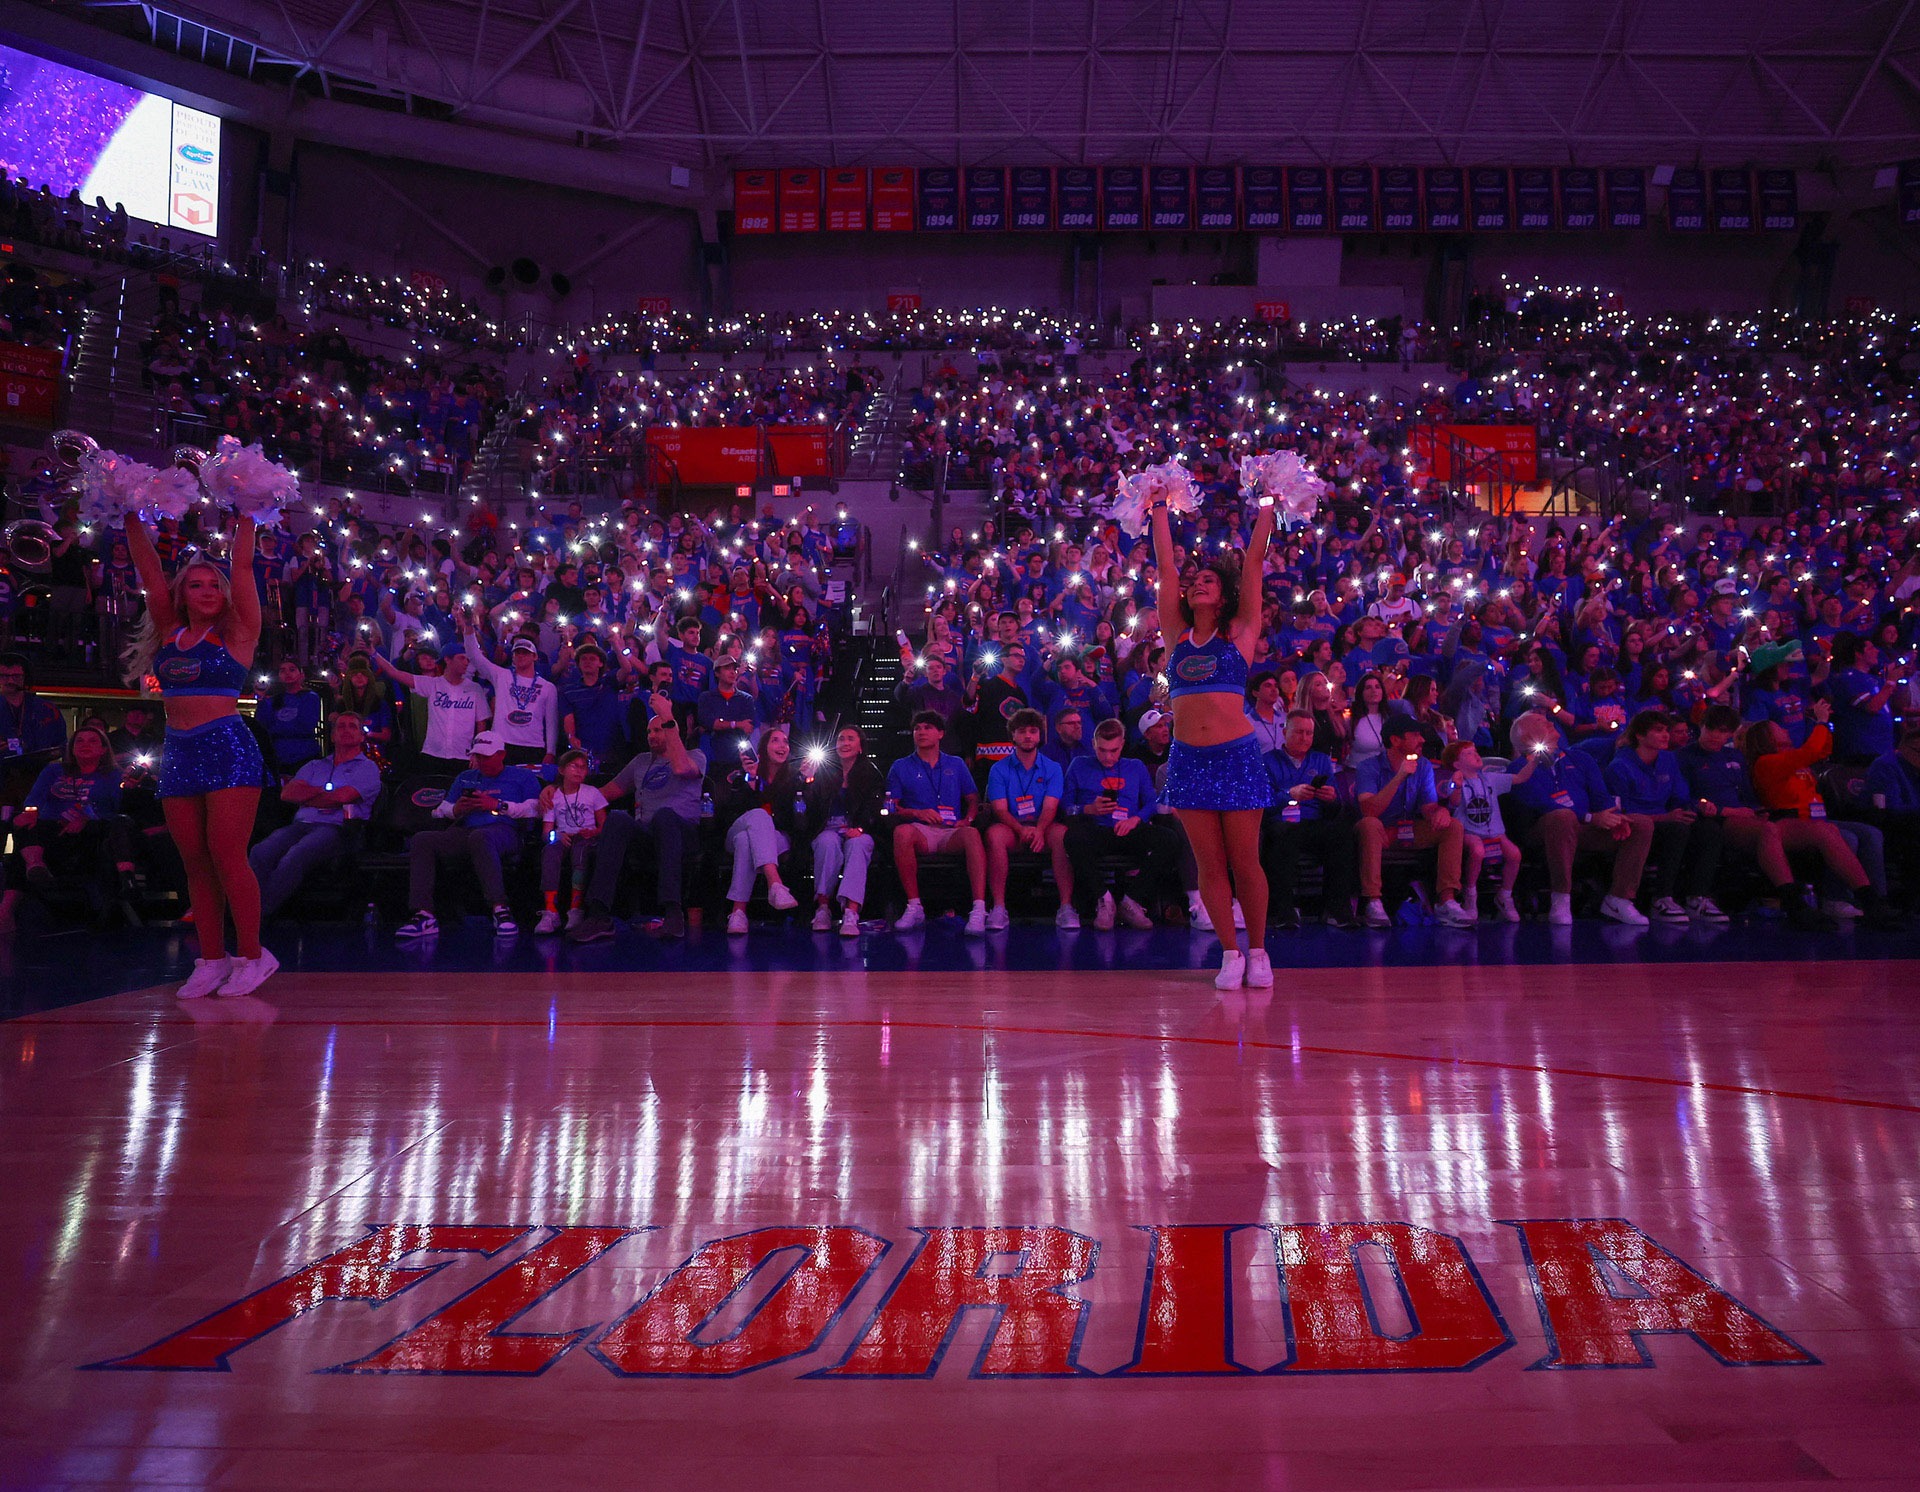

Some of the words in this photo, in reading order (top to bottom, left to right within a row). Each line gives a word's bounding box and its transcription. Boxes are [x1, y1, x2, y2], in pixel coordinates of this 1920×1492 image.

[176, 111, 217, 129] PROUD
[742, 217, 768, 229] 1982
[926, 214, 953, 226] 1994
[972, 213, 1000, 226] 1997
[1018, 213, 1045, 225] 1998
[1062, 213, 1093, 225] 2004
[1108, 213, 1138, 225] 2006
[1154, 213, 1185, 224] 2007
[1201, 213, 1232, 225] 2008
[1249, 213, 1279, 224] 2009
[1296, 213, 1323, 225] 2010
[1341, 214, 1368, 226] 2012
[1386, 214, 1413, 226] 2013
[1432, 214, 1459, 226] 2014
[1477, 214, 1504, 226] 2015
[1522, 214, 1549, 226] 2016
[1567, 214, 1594, 226] 2017
[1719, 216, 1749, 228] 2022
[412, 271, 445, 288] 209
[1260, 304, 1284, 318] 212
[665, 443, 681, 452] 109
[433, 691, 474, 709] Florida
[76, 1218, 1825, 1380] FLORIDA
